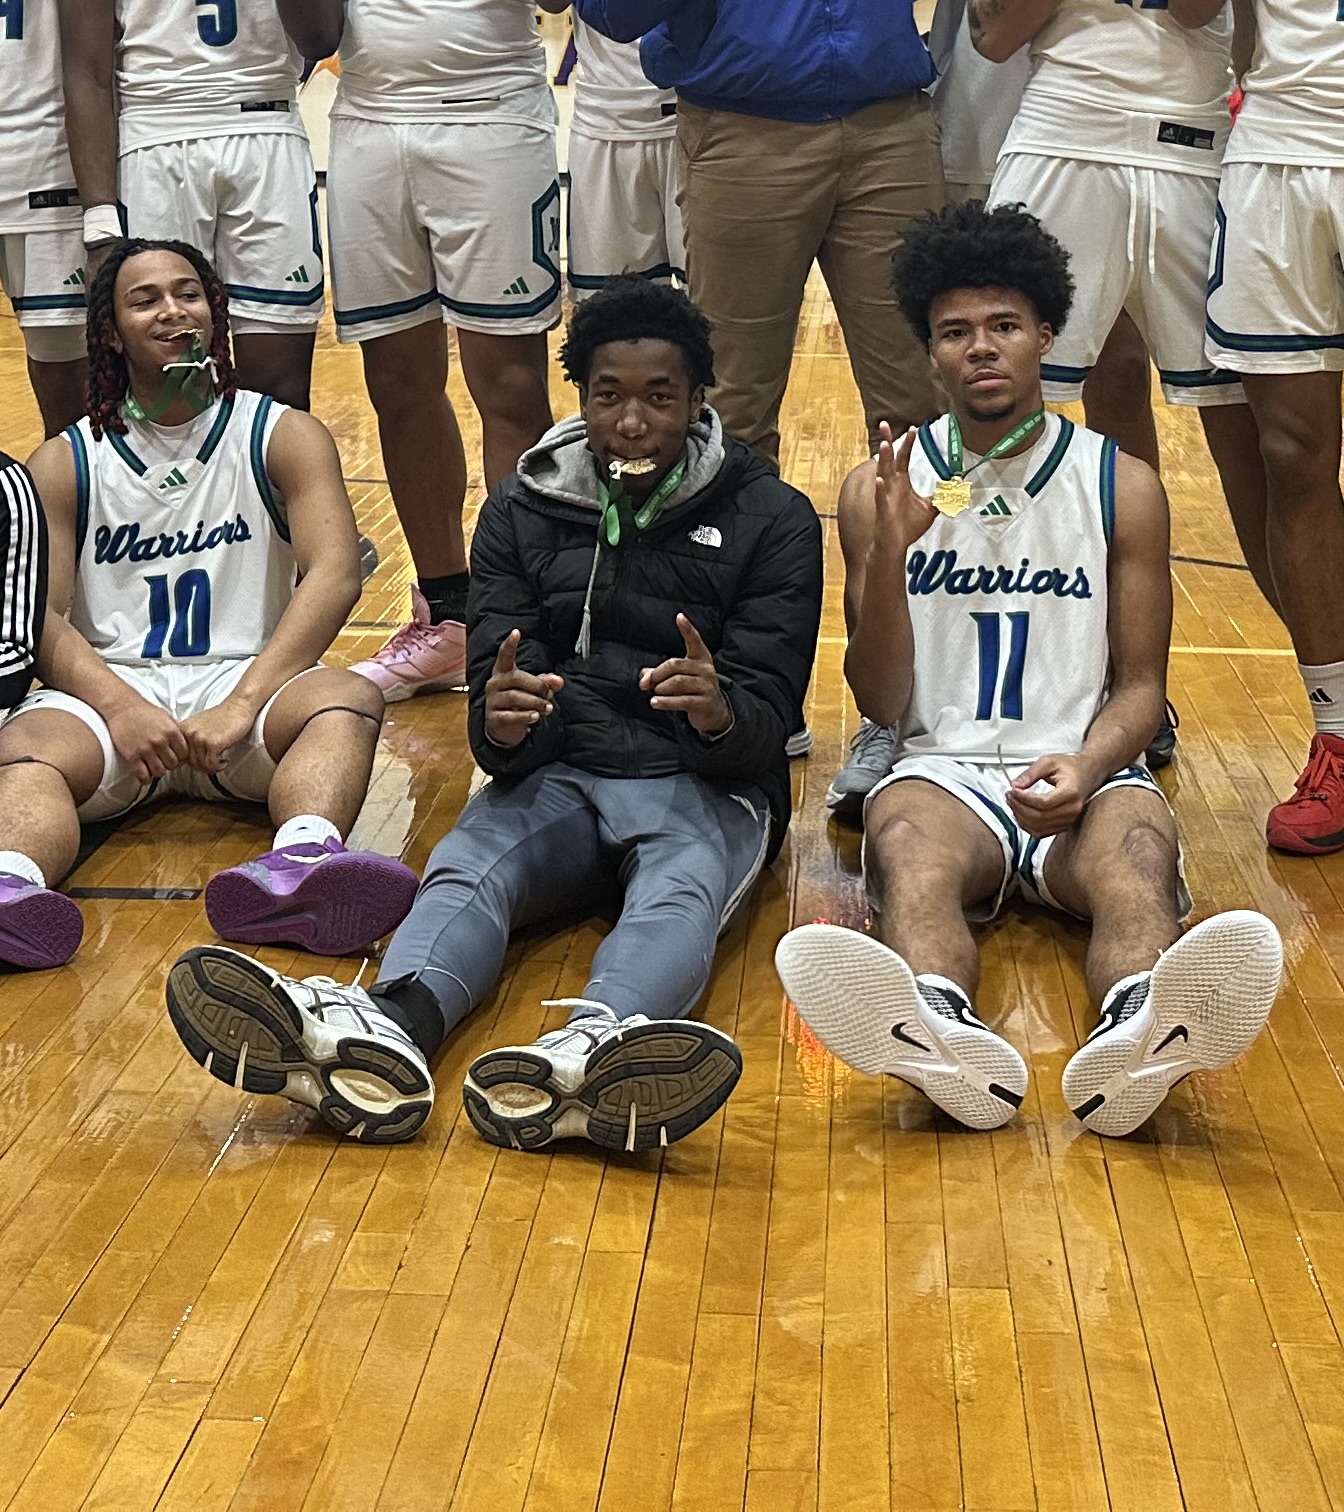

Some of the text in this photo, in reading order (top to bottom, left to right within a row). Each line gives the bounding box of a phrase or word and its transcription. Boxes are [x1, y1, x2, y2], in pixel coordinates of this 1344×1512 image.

[94, 513, 252, 565] Warriors
[907, 549, 1092, 599] Warriors
[140, 569, 211, 658] 10
[968, 611, 1030, 721] 11
